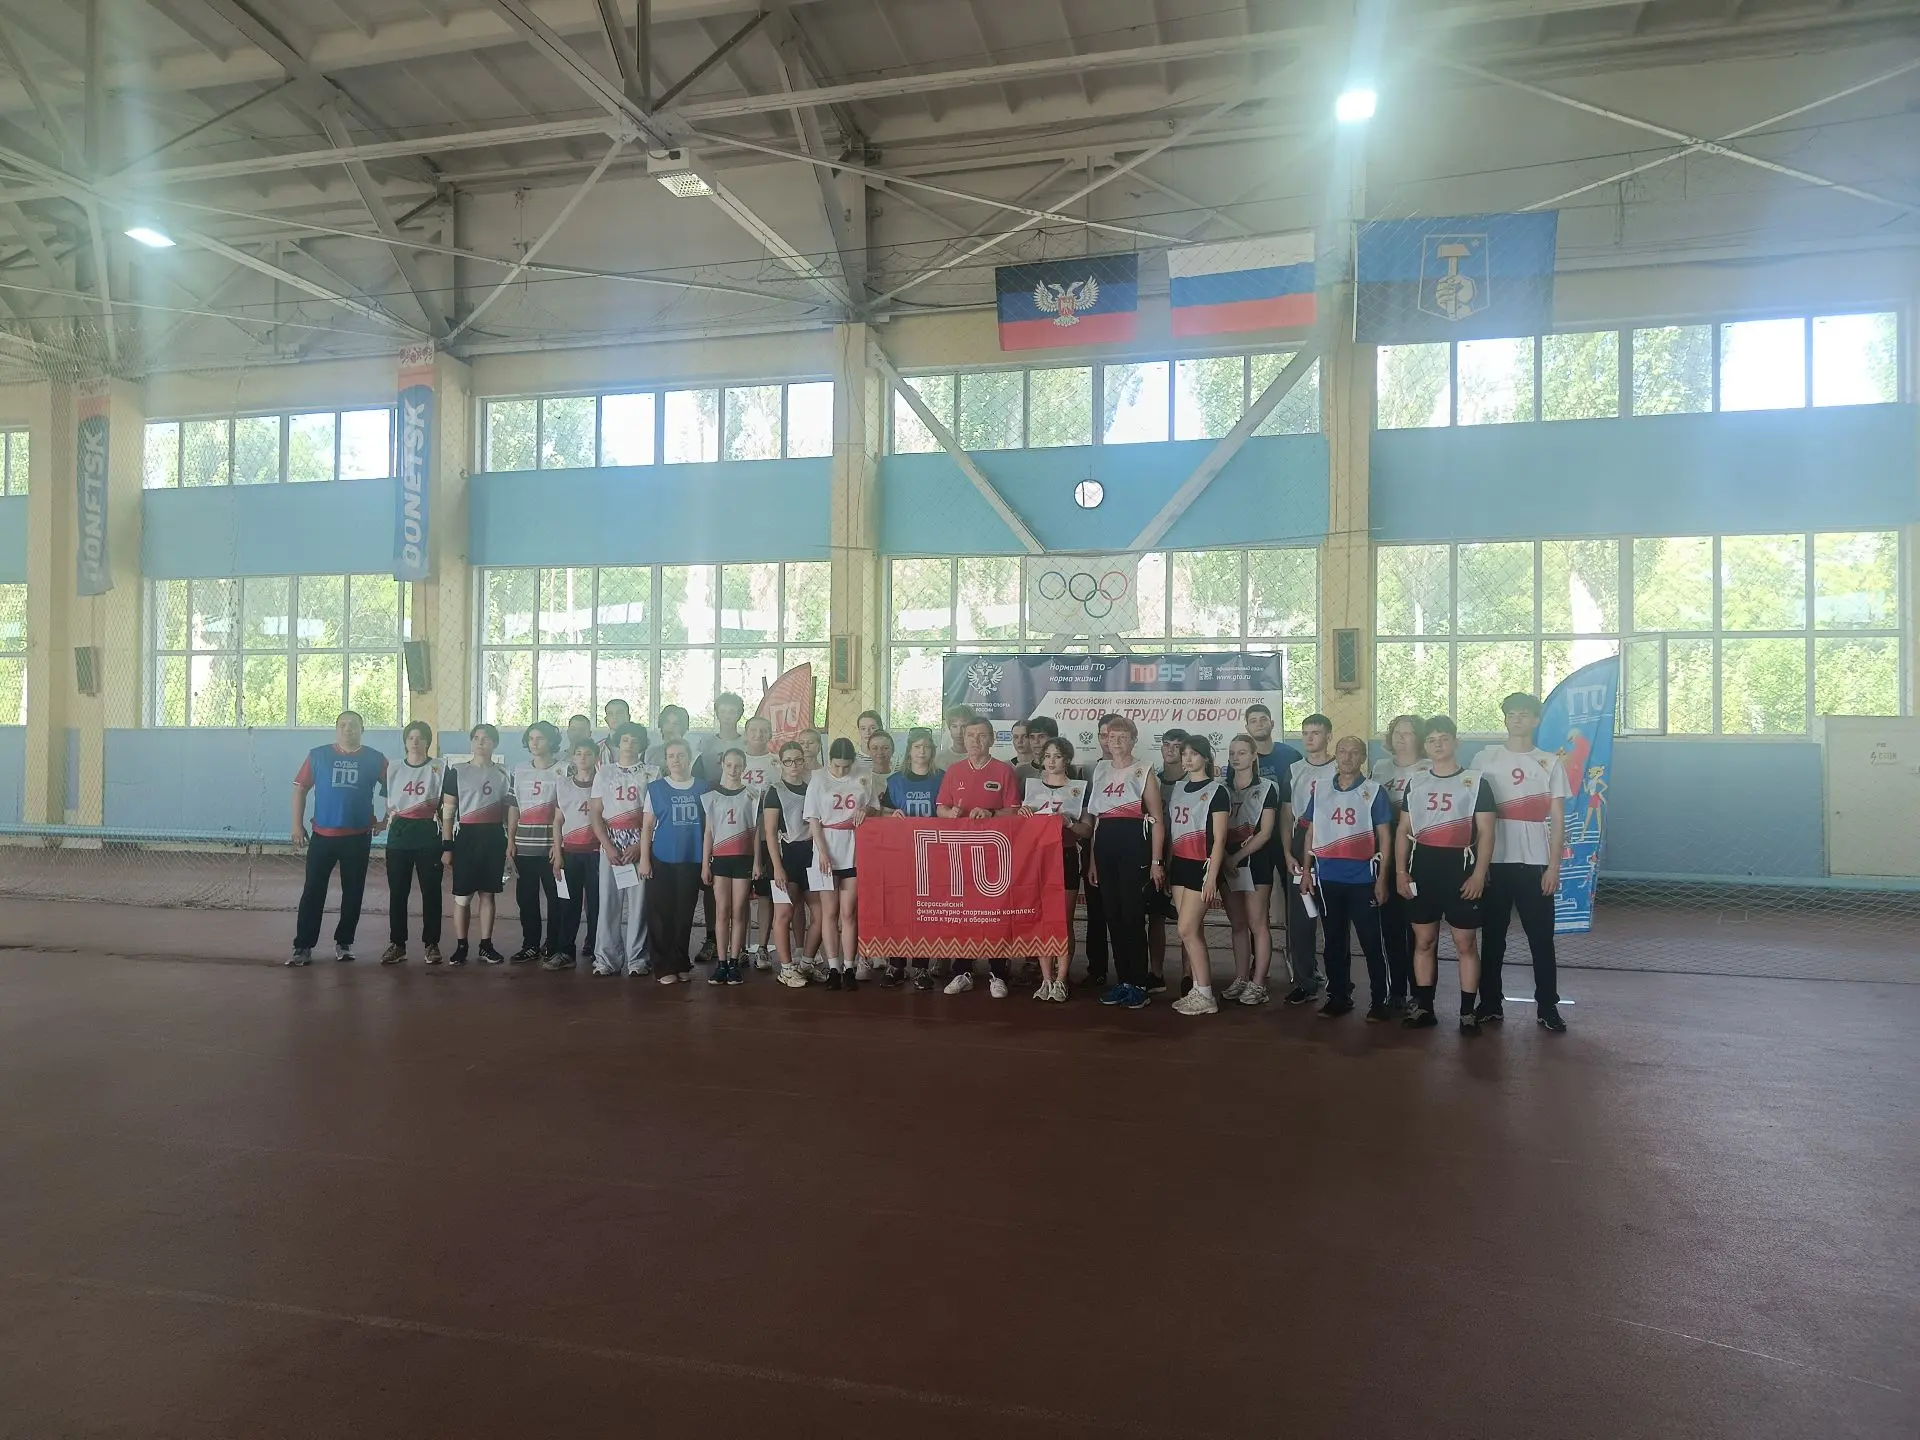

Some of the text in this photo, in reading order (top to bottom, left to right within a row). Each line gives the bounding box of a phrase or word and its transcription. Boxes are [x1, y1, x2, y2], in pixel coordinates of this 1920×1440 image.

[402, 398, 425, 569] DONETSK
[83, 428, 104, 582] DONETSK
[1049, 663, 1088, 672] Норматив
[1216, 674, 1251, 682] www.gto.ru
[1054, 696, 1112, 704] ВСЕРОССИЙСКИЙ
[1115, 696, 1221, 705] ФИЗКУЛЬТУРНО-СПОРТИВНЫЙ
[1054, 708, 1106, 721] «ГОТОВ
[1123, 708, 1170, 723] ТРУДУ
[1171, 708, 1183, 721] И
[1186, 708, 1247, 721] ОБОРОН
[743, 770, 764, 784] 43
[1512, 767, 1525, 785] 9
[403, 781, 426, 796] 46
[482, 781, 492, 795] 6
[532, 781, 541, 795] 5
[615, 786, 637, 801] 18
[906, 791, 931, 799] СУДЬЯ
[1103, 783, 1125, 797] 44
[833, 793, 856, 810] 26
[1426, 792, 1453, 811] 35
[578, 802, 590, 816] 4
[727, 808, 737, 824] 1
[1174, 806, 1189, 824] 25
[1331, 807, 1356, 825] 48
[914, 830, 1012, 897] ГТО
[917, 900, 964, 909] Всероссийский
[917, 907, 1001, 916] физкультурно-спортивный
[944, 916, 962, 924] труду
